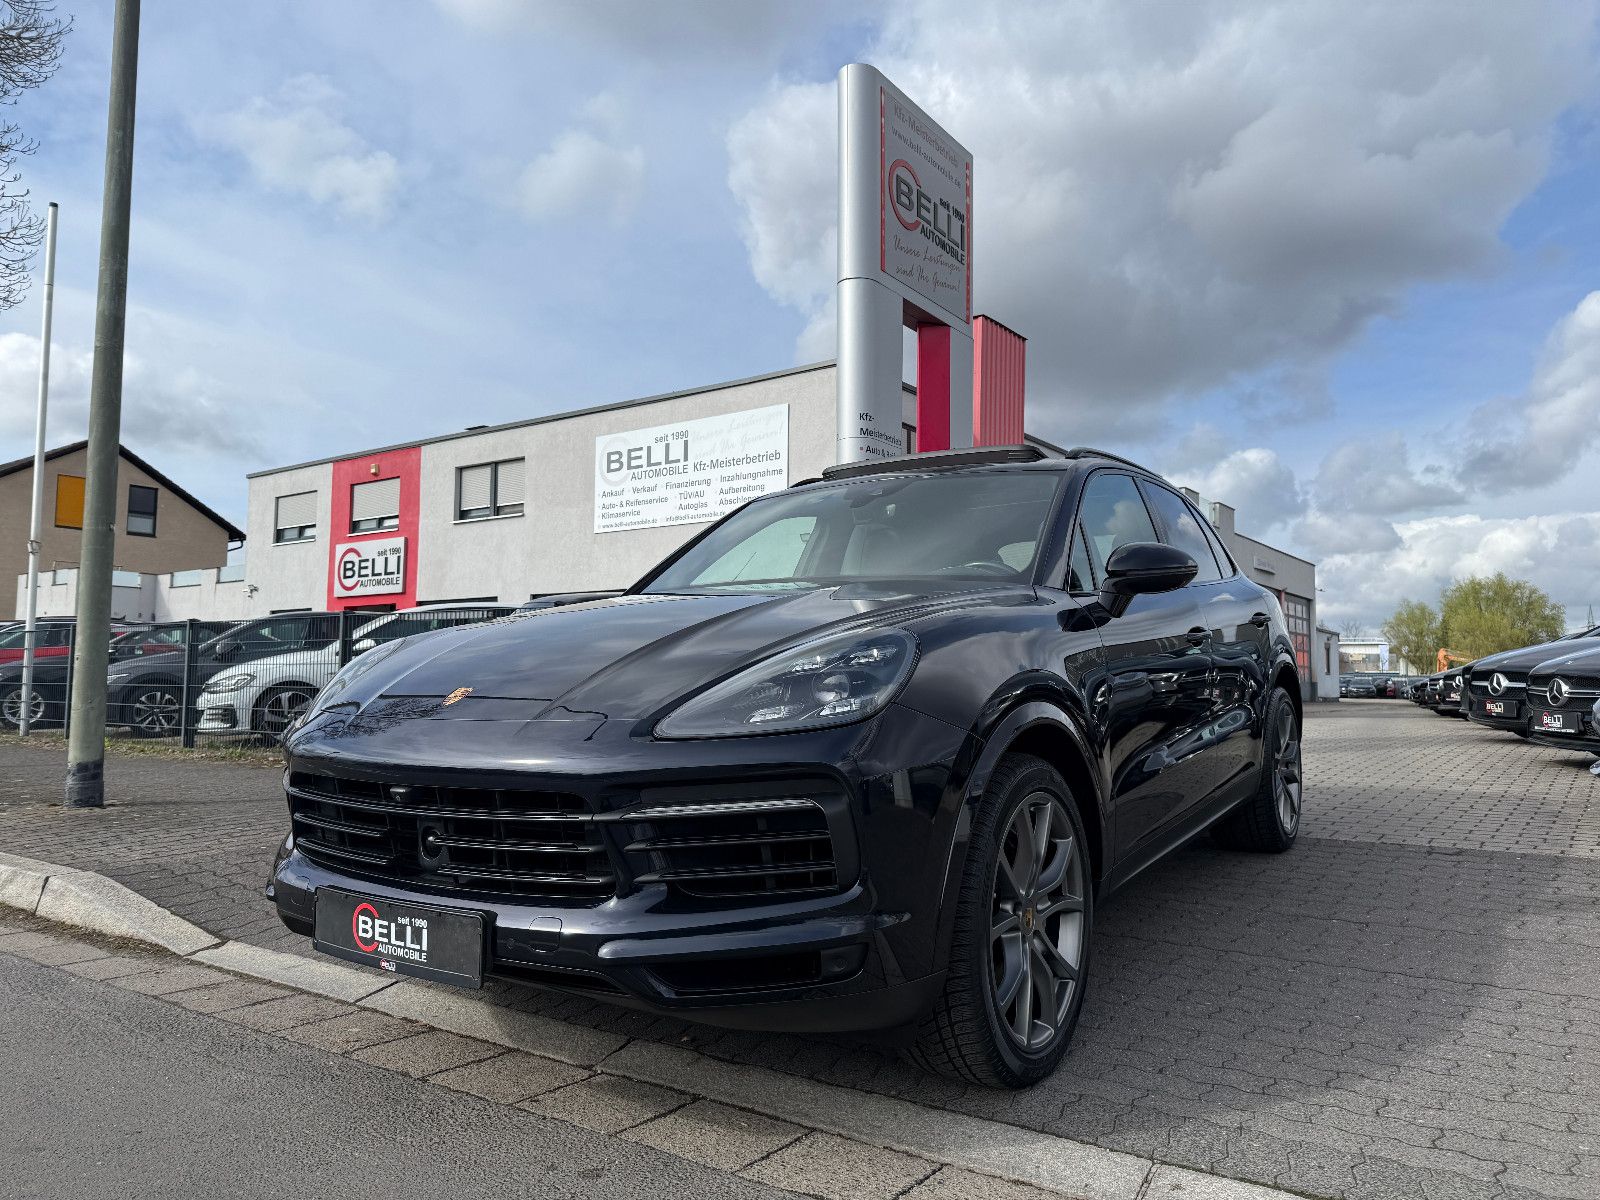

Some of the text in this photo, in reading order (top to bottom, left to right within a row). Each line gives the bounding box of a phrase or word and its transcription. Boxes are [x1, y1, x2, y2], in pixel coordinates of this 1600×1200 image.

[896, 173, 965, 252] BELLI
[951, 205, 965, 224] 1990
[920, 227, 965, 266] AUTOMOBILE
[859, 413, 874, 421] Kfz-
[654, 430, 689, 444] seit 1990
[606, 440, 689, 473] BELLI
[693, 450, 781, 473] Kfz-Meisterbetrieb
[631, 464, 688, 481] AUTOMOBILE
[601, 468, 783, 499] Ankauf Verkauf Finanzierung Inzahlungnahme
[626, 496, 668, 508] Reifenservice
[719, 483, 765, 496] Aufbereitung
[601, 509, 640, 520] Klimaservice
[678, 501, 708, 511] Autoglas
[389, 547, 401, 555] 1990
[343, 555, 401, 579] BELLI
[360, 577, 400, 588] AUTOMOBILE
[398, 916, 427, 928] seit 1990
[358, 914, 428, 951] BELLI
[378, 945, 427, 963] AUTOMOBILE
